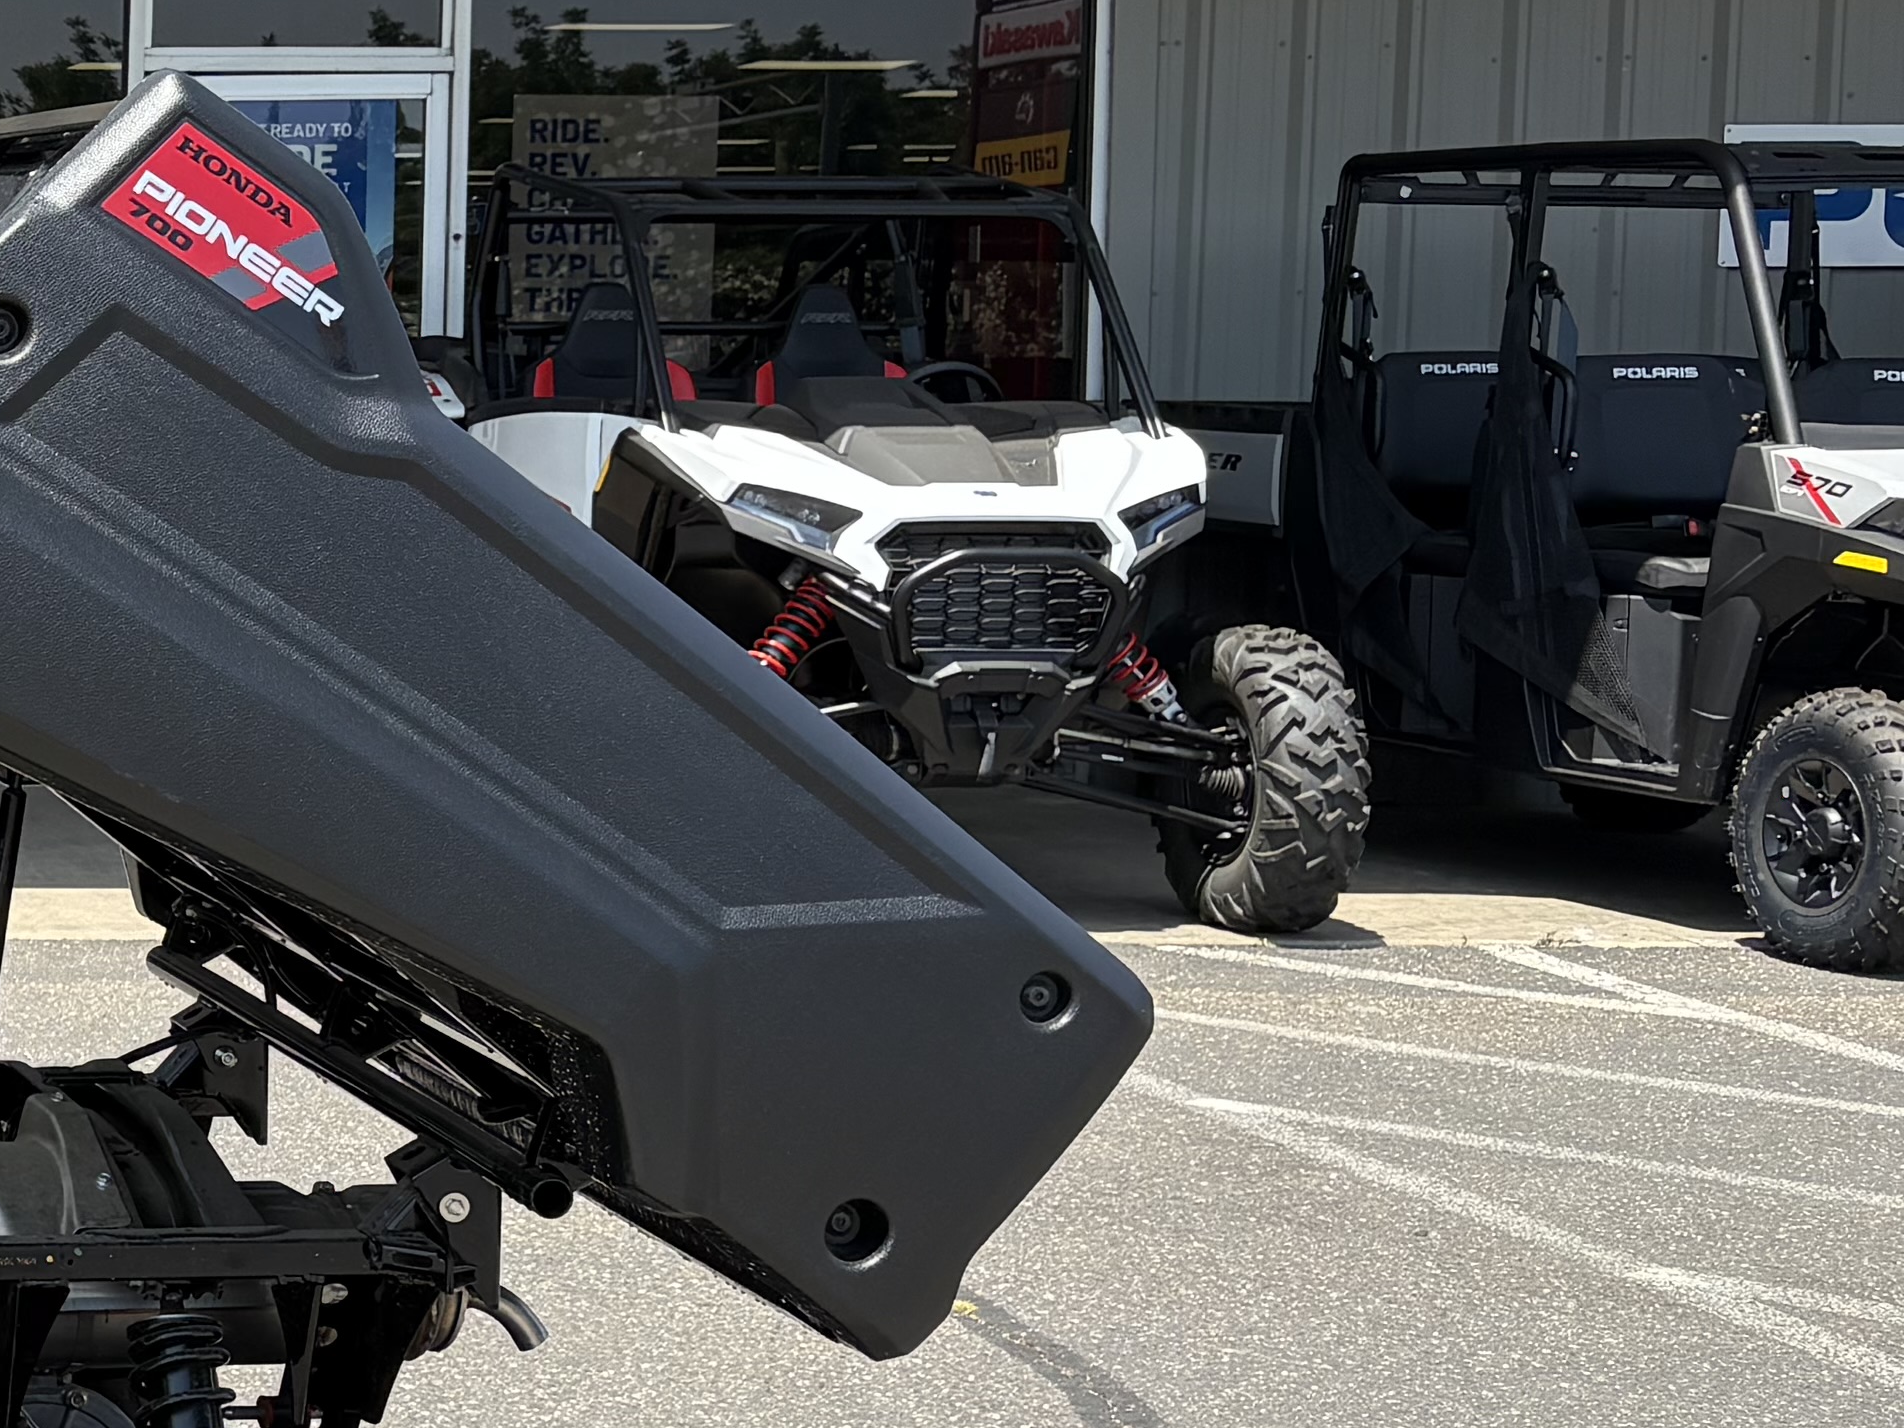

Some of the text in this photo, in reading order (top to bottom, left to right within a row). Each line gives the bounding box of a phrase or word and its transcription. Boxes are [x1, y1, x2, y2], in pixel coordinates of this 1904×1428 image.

[270, 123, 327, 138] READY
[330, 123, 352, 137] TO
[529, 118, 610, 144] RIDE.
[174, 135, 294, 228] HONDA
[127, 198, 195, 252] 700
[132, 170, 346, 328] PIONEER
[524, 254, 679, 280] EXPLOE.
[1420, 362, 1500, 376] POLARIS
[1612, 366, 1700, 380] POLARIS
